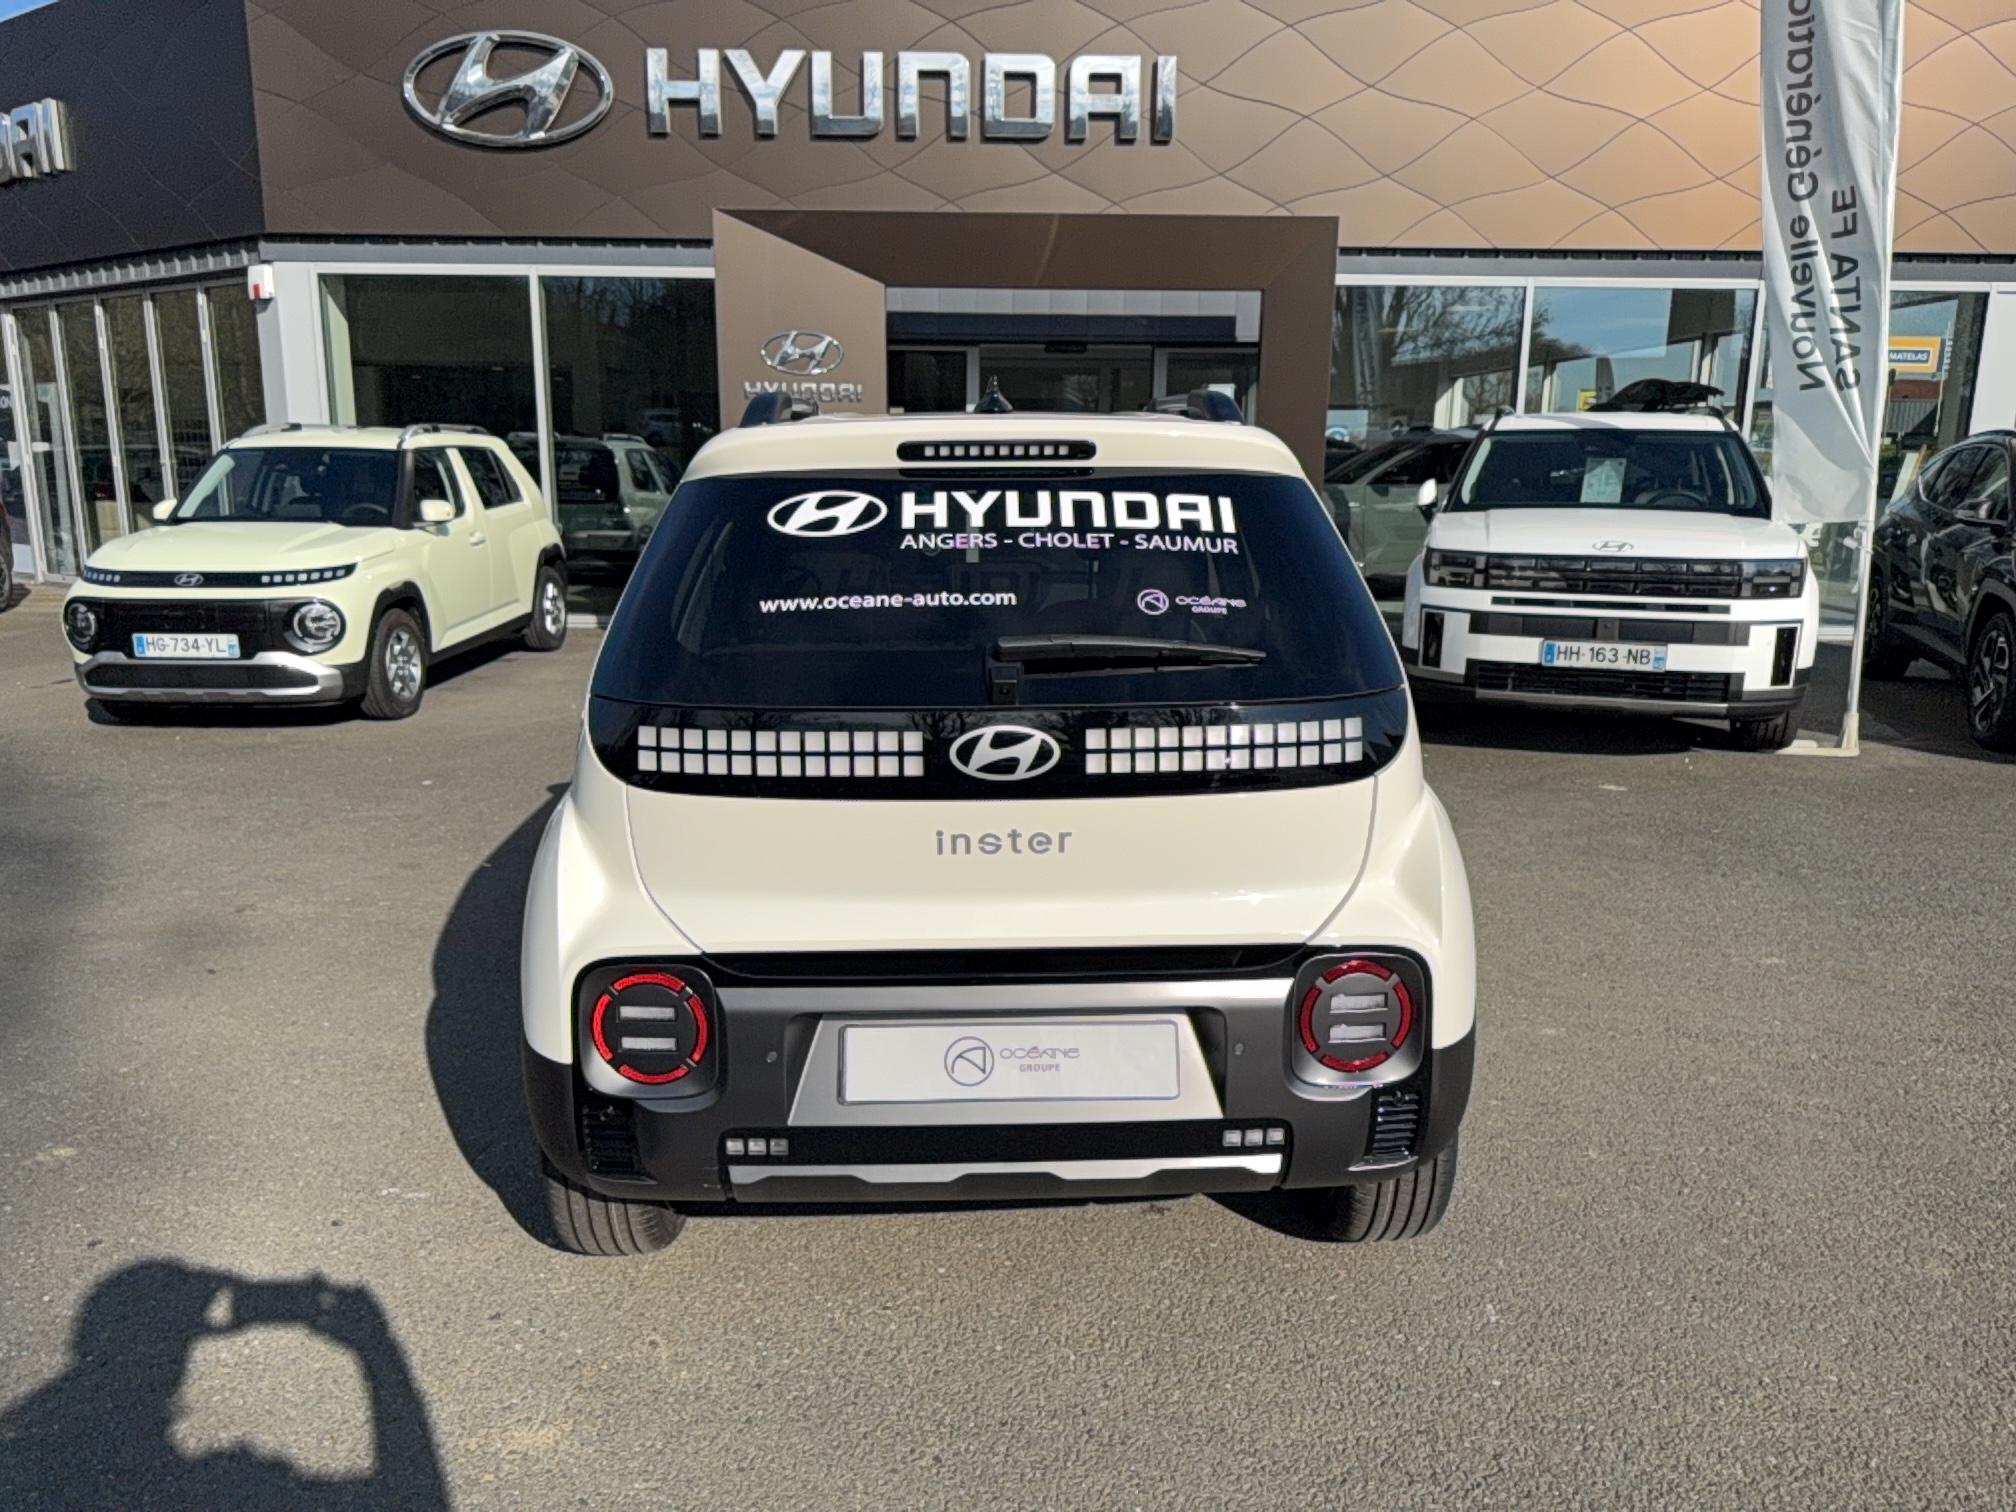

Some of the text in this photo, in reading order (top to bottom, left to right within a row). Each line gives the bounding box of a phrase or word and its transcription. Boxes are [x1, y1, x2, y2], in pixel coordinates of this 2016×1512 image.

[645, 47, 1178, 142] HYUNDAI
[0, 97, 68, 183] AI
[1889, 351, 1928, 361] MATELAS
[900, 490, 1237, 533] HYUNDAI
[899, 532, 998, 550] ANGERS
[1018, 532, 1116, 550] CHOLET
[1134, 533, 1240, 555] SAUMUR
[759, 590, 1018, 613] www.oceane-auto.com
[935, 828, 1073, 856] inster
[1019, 1063, 1061, 1073] GROUPE
